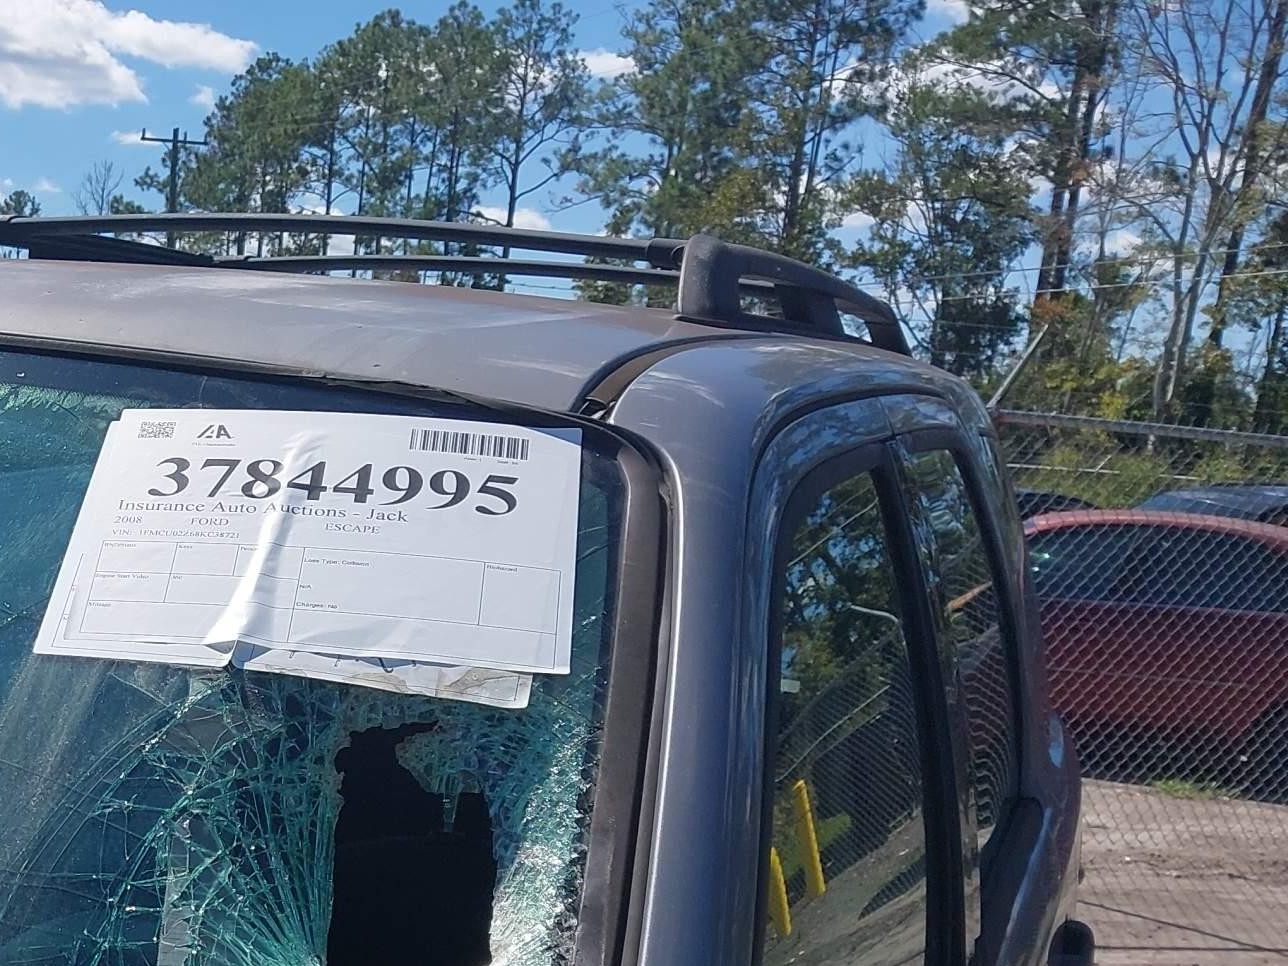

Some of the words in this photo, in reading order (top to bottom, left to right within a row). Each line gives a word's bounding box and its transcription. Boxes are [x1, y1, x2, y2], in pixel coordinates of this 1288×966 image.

[147, 457, 519, 516] 37844995
[118, 499, 206, 512] Insurance
[211, 502, 257, 514] Auto
[263, 502, 347, 518] Auctions
[366, 508, 409, 523] Jack
[113, 516, 143, 524] 2008
[190, 517, 230, 526] FORD
[325, 523, 381, 534] ESCAPE
